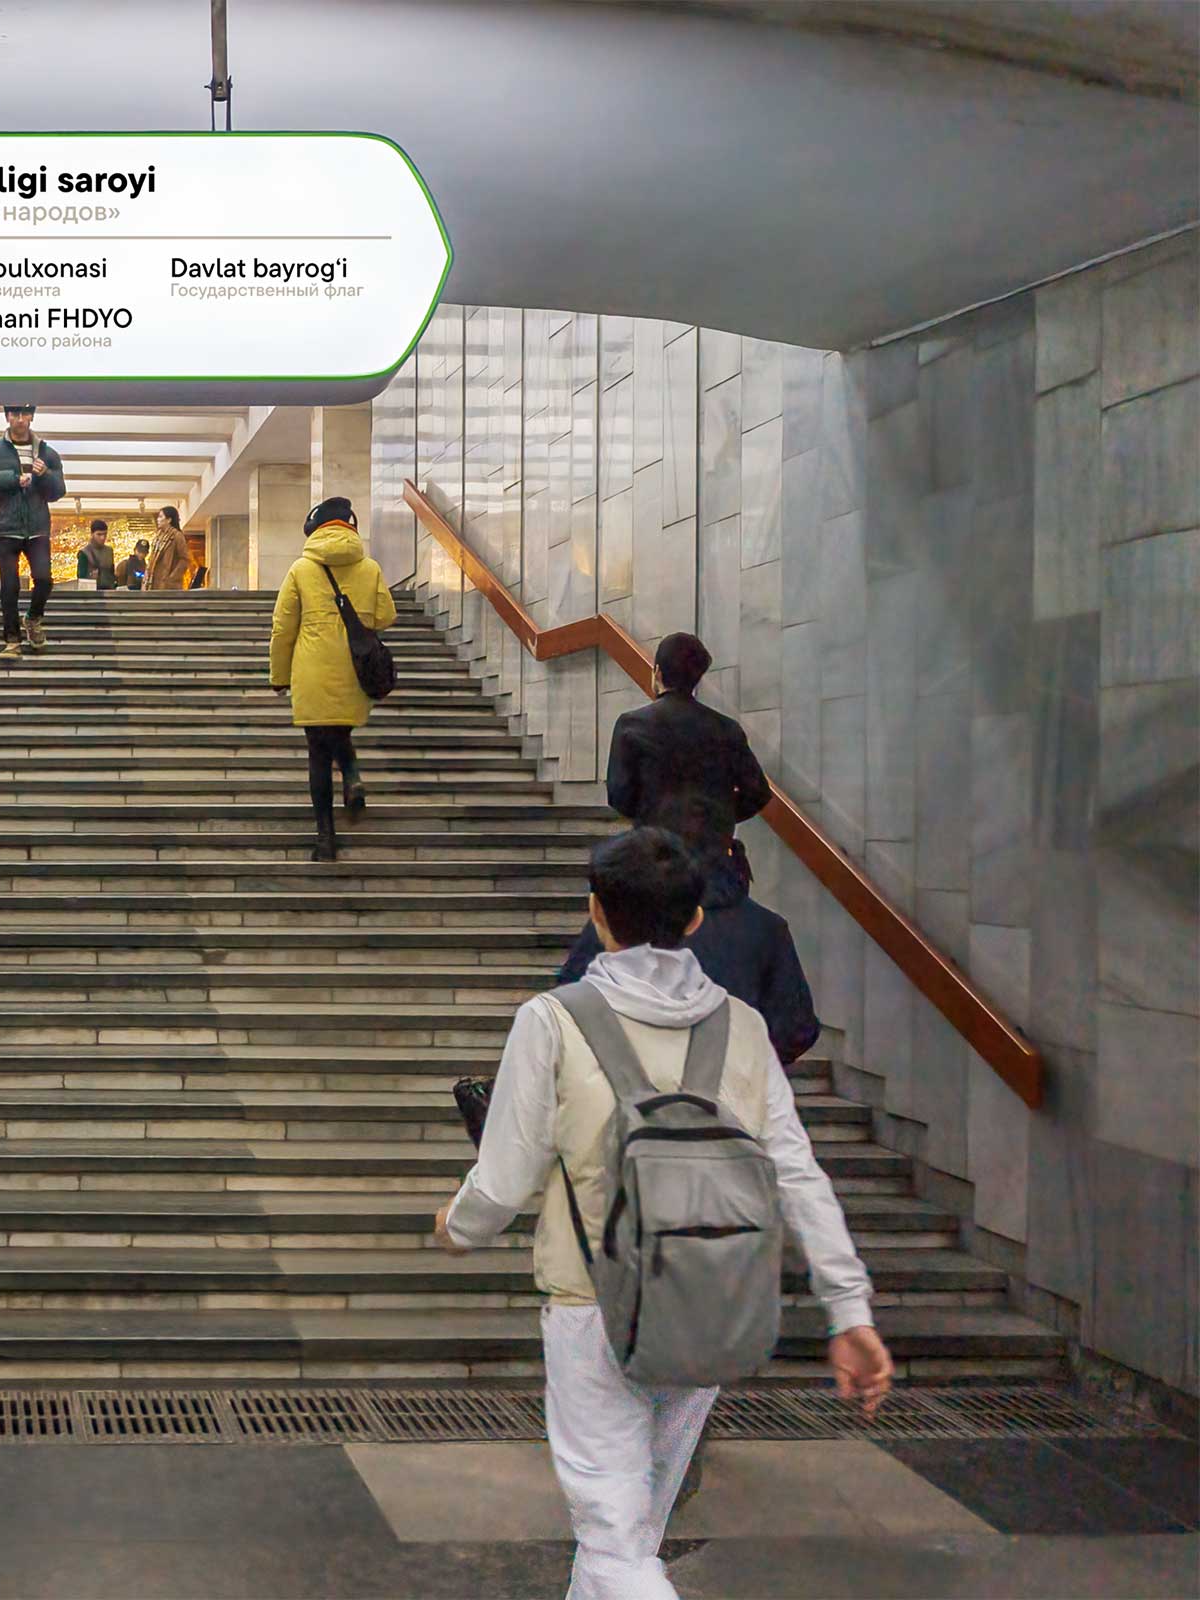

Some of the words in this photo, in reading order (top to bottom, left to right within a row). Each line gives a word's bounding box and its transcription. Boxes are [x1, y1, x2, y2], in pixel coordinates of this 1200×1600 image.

[57, 165, 156, 199] saroyi
[3, 206, 120, 225] народов»
[171, 258, 246, 278] Davlat
[171, 283, 319, 299] Государственный
[324, 283, 364, 299] флаг
[47, 308, 133, 328] FHDYO
[51, 334, 112, 350] района
